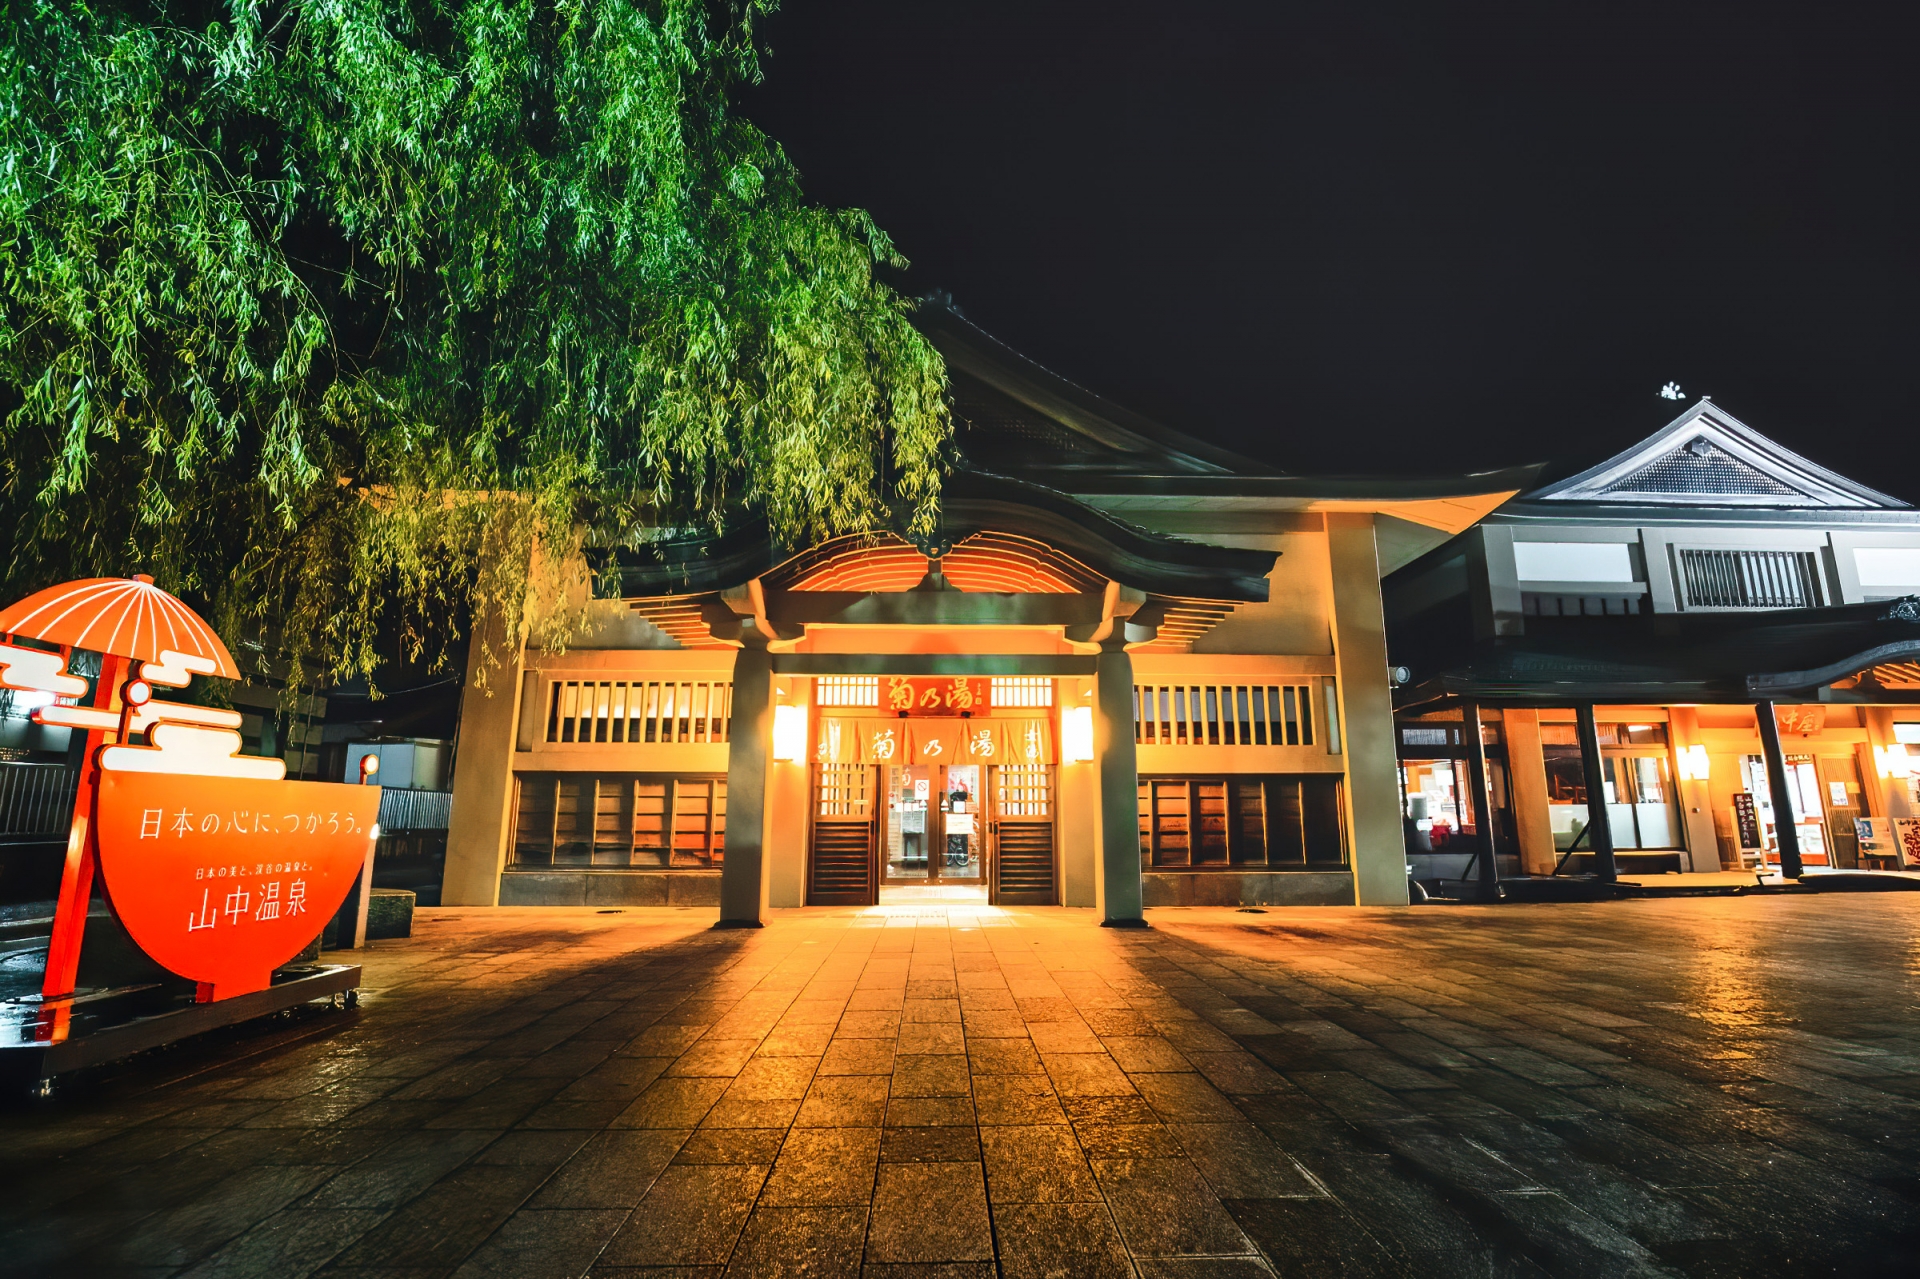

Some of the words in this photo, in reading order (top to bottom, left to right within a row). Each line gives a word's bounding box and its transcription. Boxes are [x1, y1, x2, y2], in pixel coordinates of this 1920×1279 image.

[888, 677, 973, 710] 菊乃湯
[1777, 709, 1815, 733] 中座
[873, 729, 995, 759] 菊乃湯
[139, 807, 361, 839] 日本の心に、つかろう。
[188, 877, 307, 932] 山中温泉
